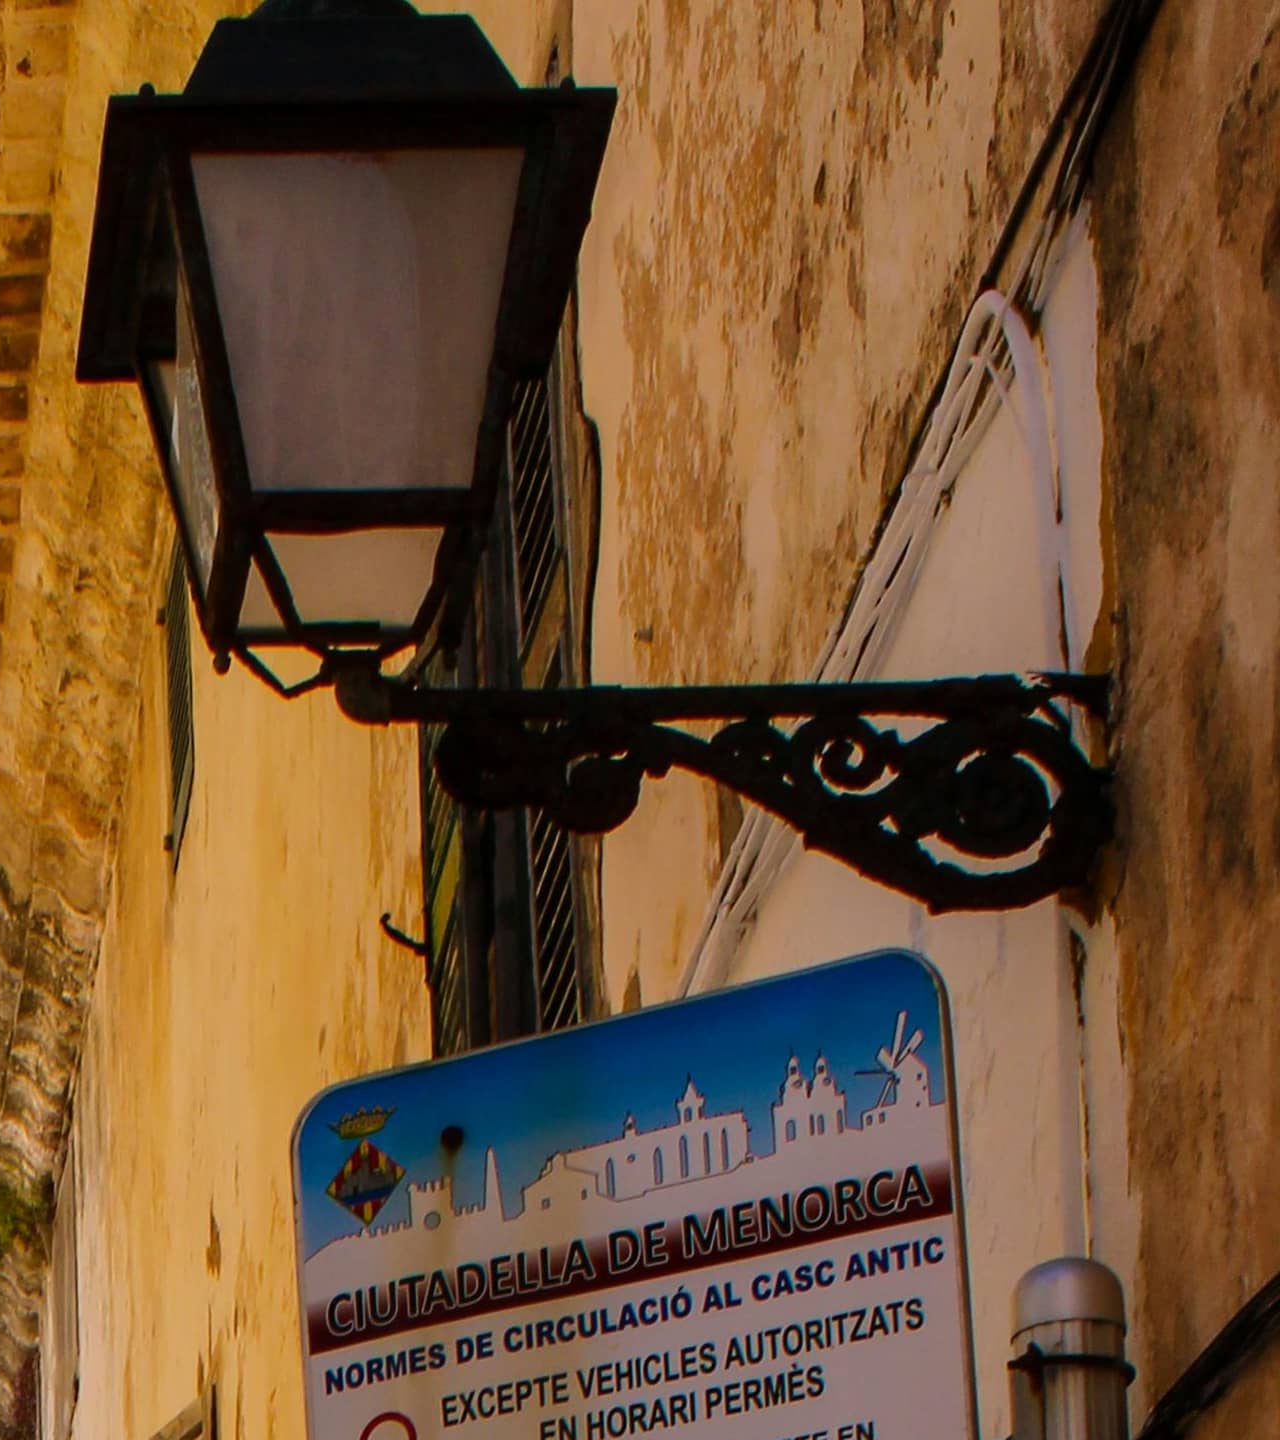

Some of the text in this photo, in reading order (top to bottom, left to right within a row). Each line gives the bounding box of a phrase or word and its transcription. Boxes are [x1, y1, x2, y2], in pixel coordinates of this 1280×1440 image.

[324, 1236, 945, 1395] NORMES DE CIRCULACIÓ AL CASC ANTIC
[326, 1163, 934, 1337] CIUTADELLA DE MENORCA
[441, 1296, 925, 1428] EXCEPTE VEHICLES AUTORITZATS
[705, 1362, 826, 1420] PERMÈS
